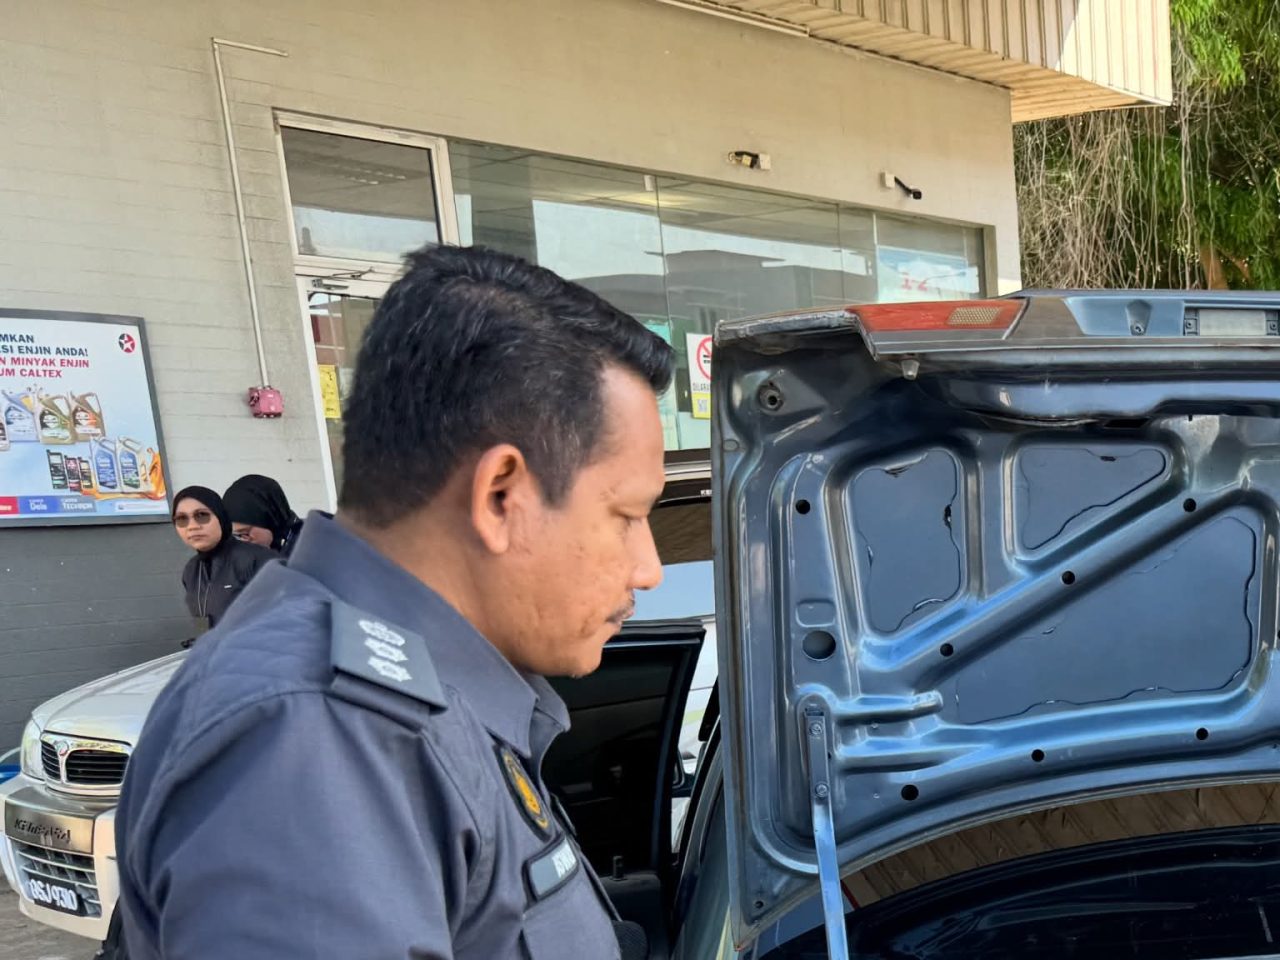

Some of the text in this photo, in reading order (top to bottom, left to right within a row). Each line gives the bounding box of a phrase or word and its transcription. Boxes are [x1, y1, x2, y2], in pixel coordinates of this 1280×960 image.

[18, 345, 51, 355] ENJIN
[55, 347, 88, 357] ANDA!
[11, 357, 56, 367] MINYAK
[60, 359, 89, 368] ENJIN
[20, 369, 62, 378] CALTEX
